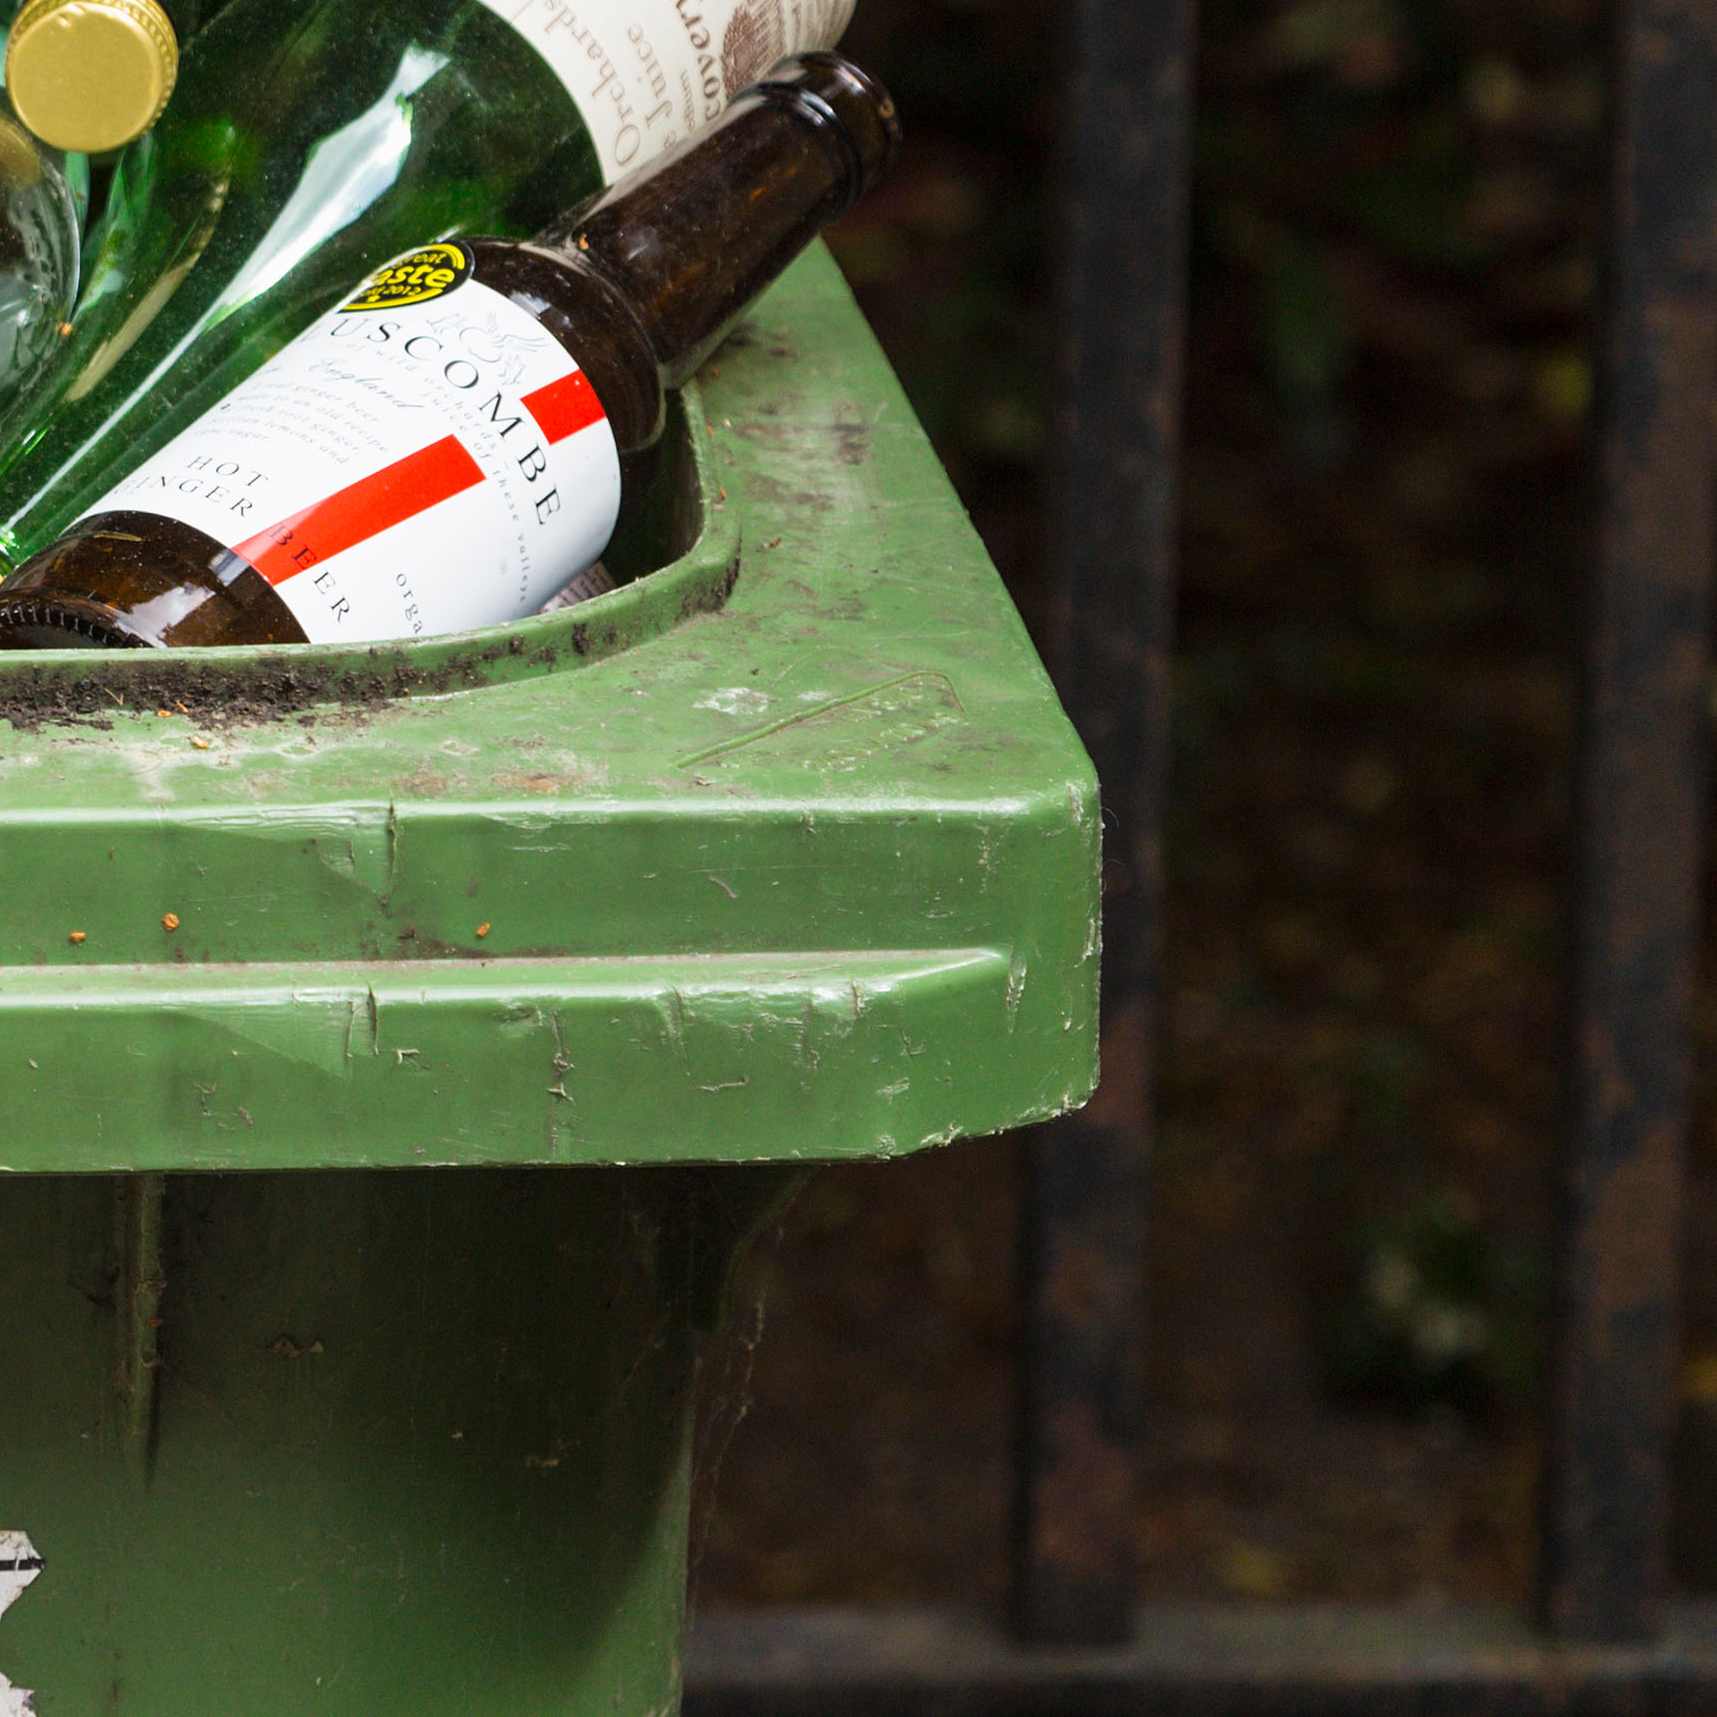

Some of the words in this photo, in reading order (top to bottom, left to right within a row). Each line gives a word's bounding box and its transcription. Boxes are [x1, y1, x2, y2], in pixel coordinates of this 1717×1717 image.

[625, 22, 673, 132] Juice
[677, 68, 695, 132] edium
[372, 262, 455, 293] aste
[186, 454, 269, 487] HOT
[268, 523, 351, 624] BEER
[493, 468, 521, 522] these
[516, 531, 529, 606] valleys
